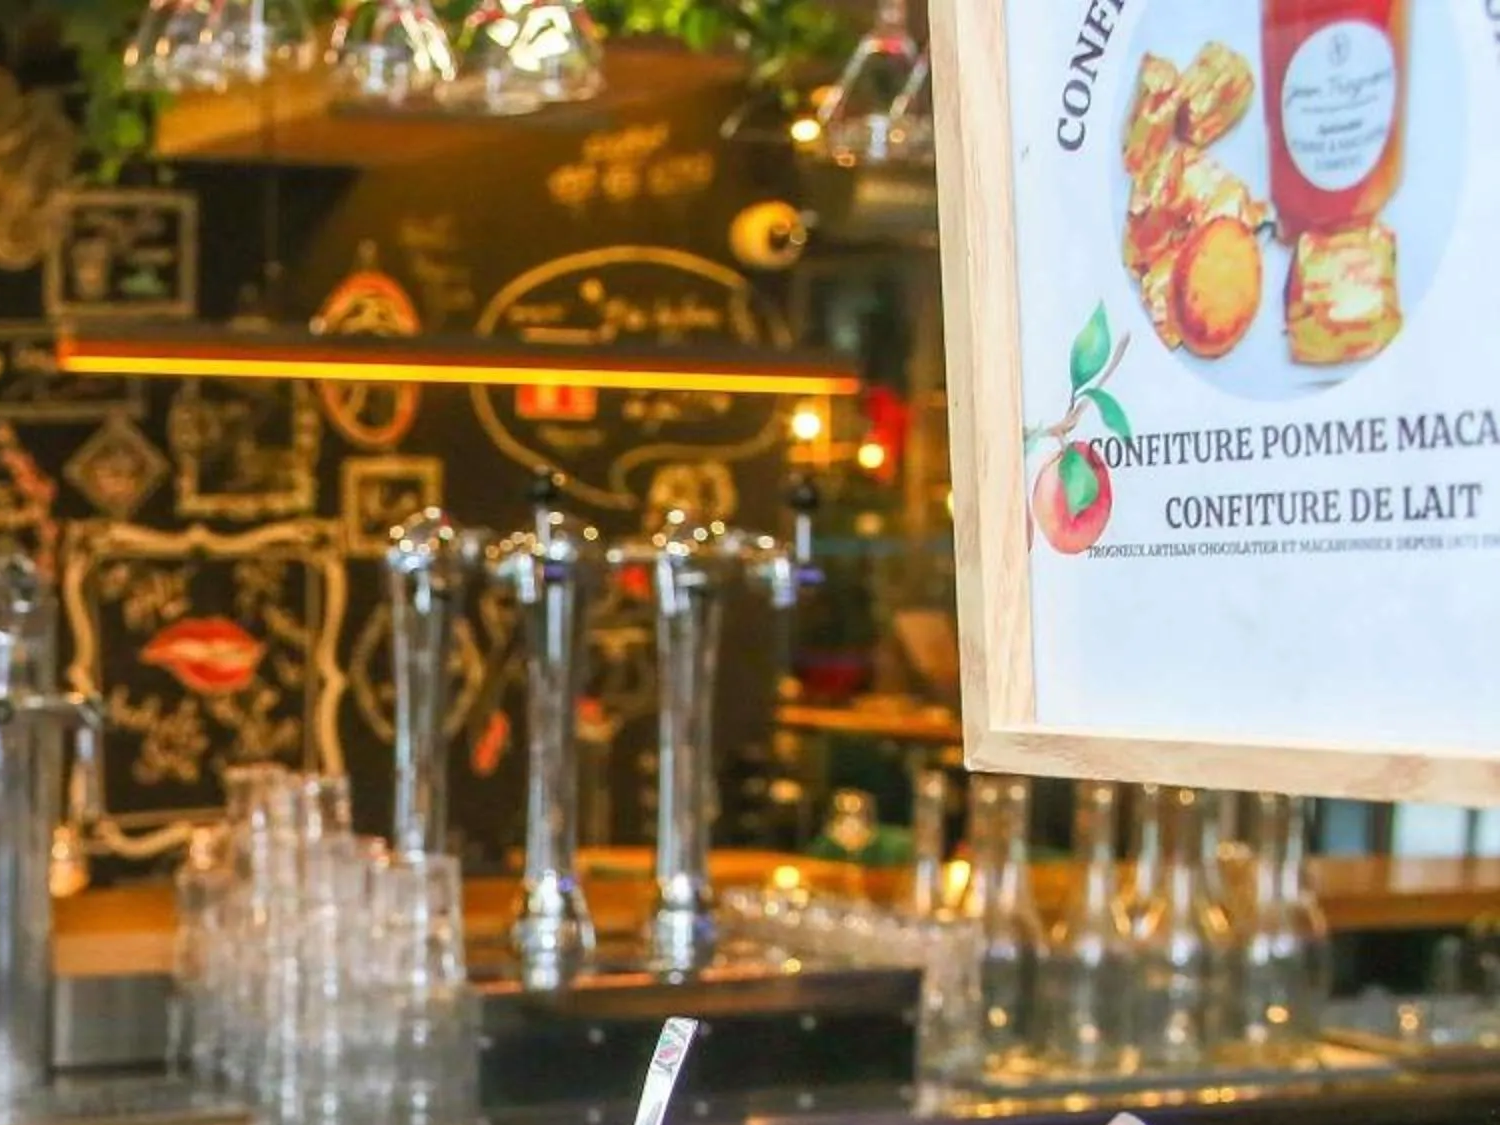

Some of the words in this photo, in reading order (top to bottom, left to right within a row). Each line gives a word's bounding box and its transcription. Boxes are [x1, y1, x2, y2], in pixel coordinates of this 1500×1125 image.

[1089, 427, 1253, 468] CONFITURE
[1262, 417, 1388, 458] POMME
[1165, 489, 1342, 529] CONFITURE
[1349, 486, 1395, 525] DE
[1402, 483, 1483, 521] LAIT
[1199, 540, 1276, 556] CHOCOLATIER
[1278, 539, 1297, 554] ET
